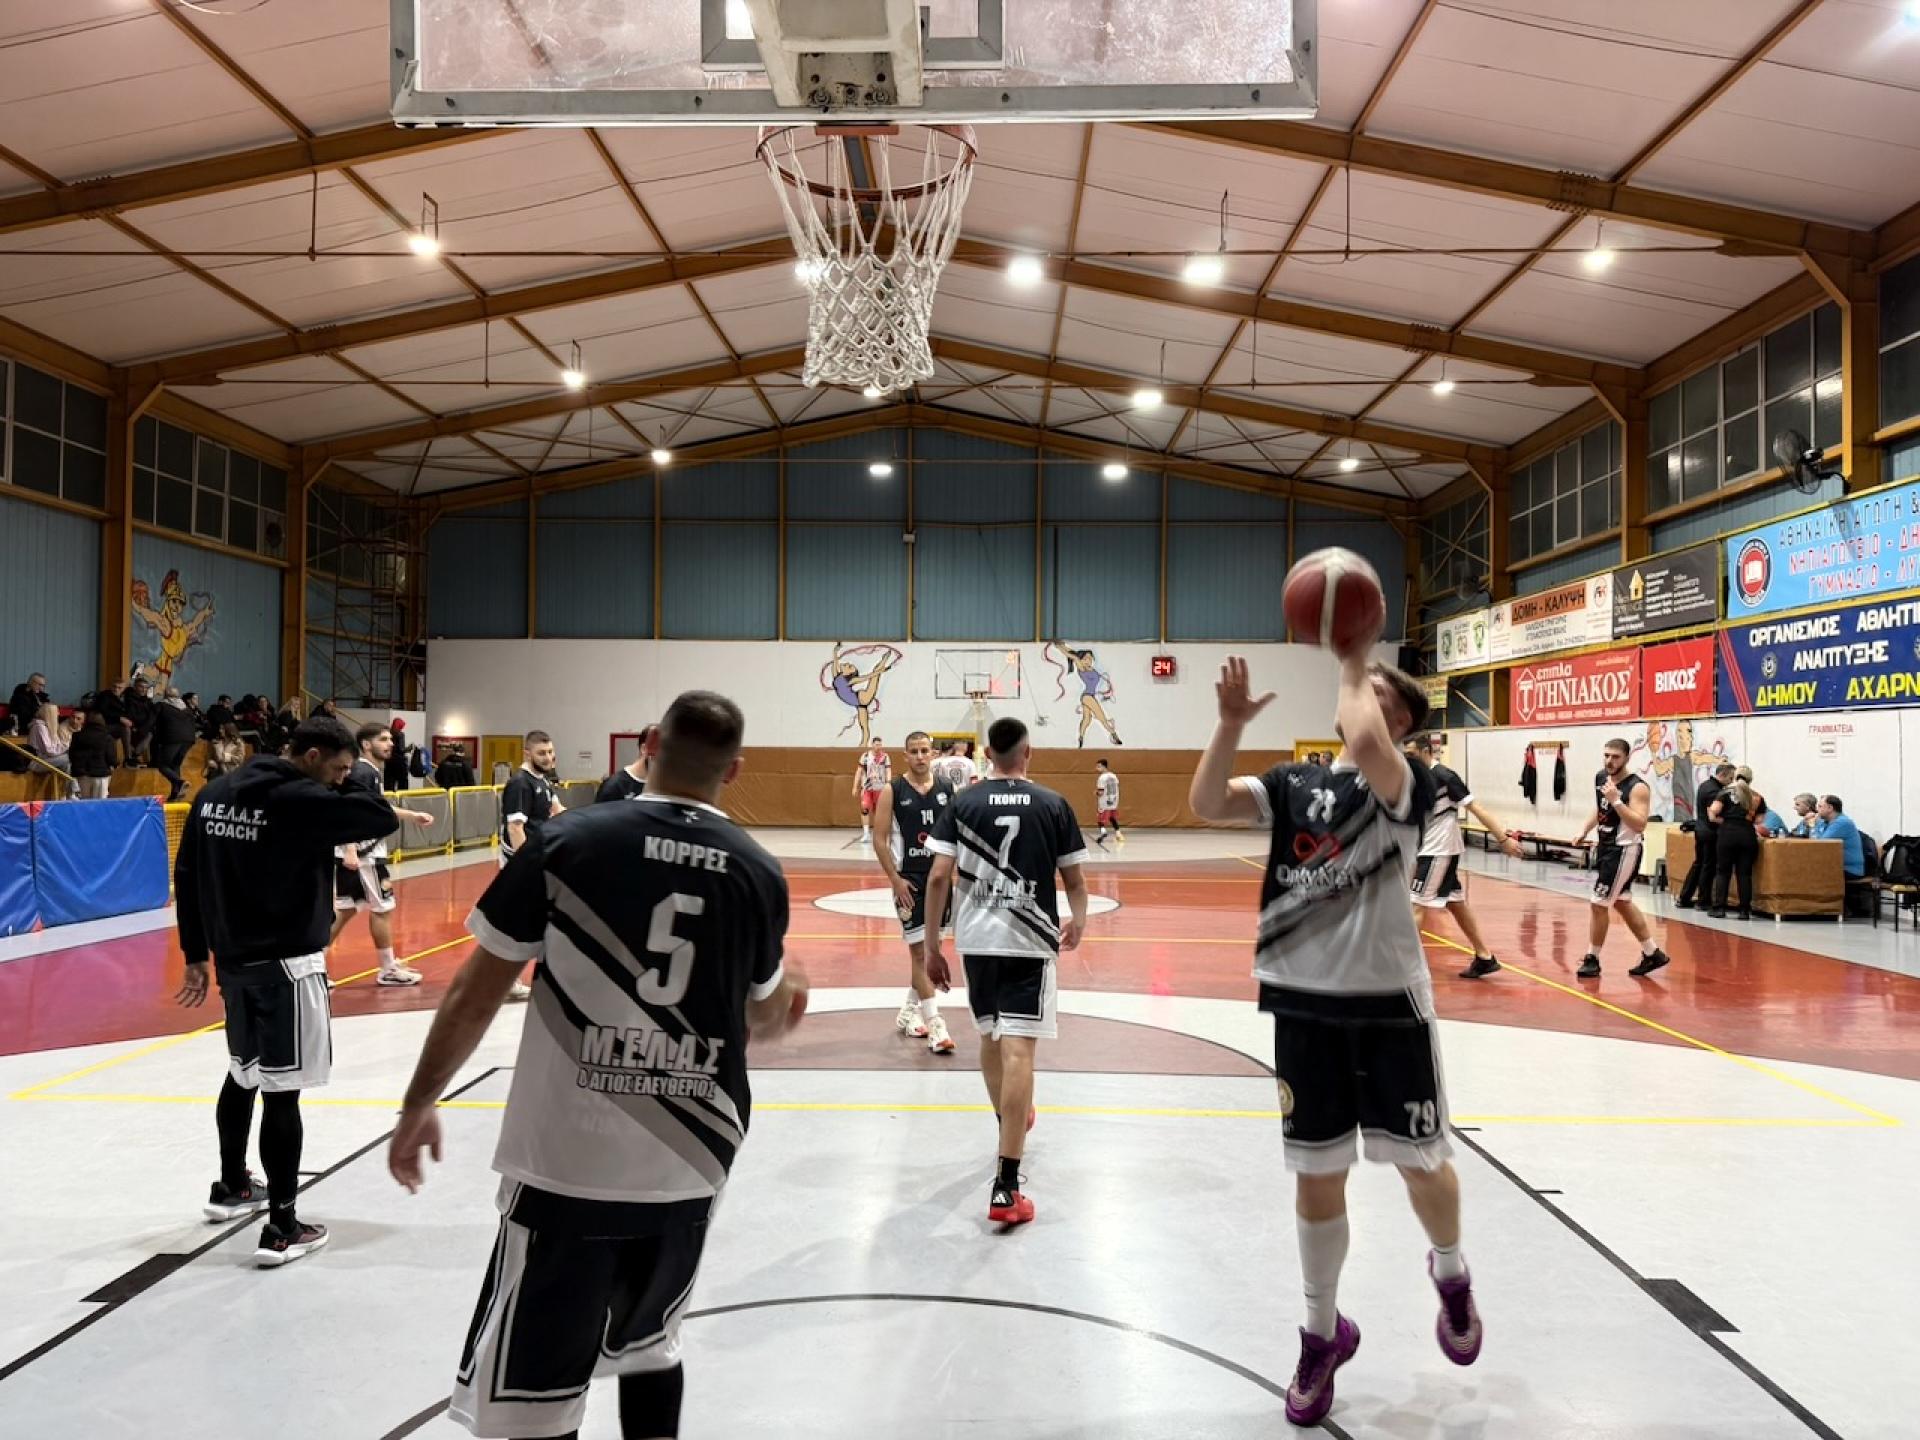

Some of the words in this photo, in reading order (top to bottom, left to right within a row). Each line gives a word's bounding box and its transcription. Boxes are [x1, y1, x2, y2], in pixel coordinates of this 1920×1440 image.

[1513, 602, 1538, 621] ΔΟΜΗ
[1545, 586, 1585, 612] ΚΑΛΥΨΗ
[1750, 614, 1841, 648] ΟΡΓΑΝΙΣΜΟΣ
[1154, 661, 1171, 675] 24
[1793, 640, 1890, 673] ΑΝΑΠΤΥΞΗΣ
[1536, 671, 1632, 709] ΤΗΝΙΑΚΟΣ
[1755, 681, 1818, 708] ΔΗΜΟΥ
[200, 802, 268, 826] Μ.Ε.Λ.Α.Σ.
[989, 793, 1031, 805] ΓΚΟΝΤΟ
[206, 820, 259, 841] COACH
[920, 809, 934, 826] 14
[643, 835, 729, 874] ΚΟΡΡΕΣ
[994, 816, 1021, 869] 7
[636, 891, 705, 1006] 5
[589, 1070, 634, 1094] ΑΓΙΟΣ
[634, 1074, 716, 1100] ΕΛΕΥΘΕΡΙΟΣ
[1403, 1099, 1435, 1137] 79
